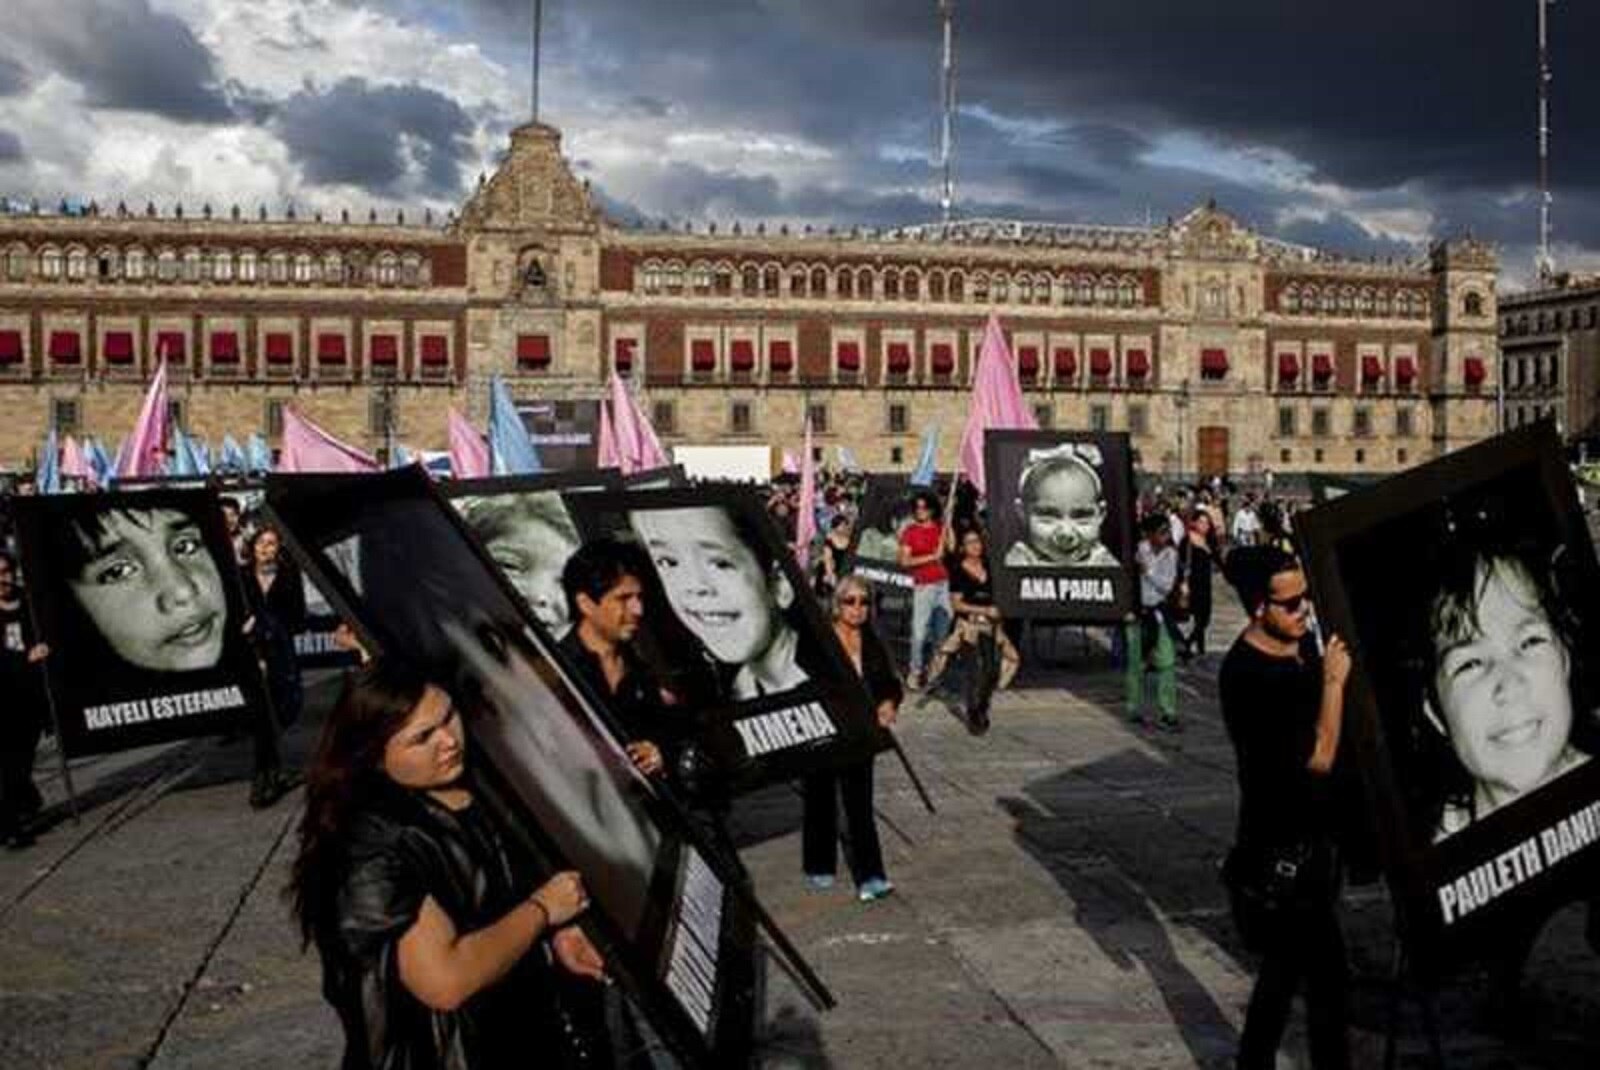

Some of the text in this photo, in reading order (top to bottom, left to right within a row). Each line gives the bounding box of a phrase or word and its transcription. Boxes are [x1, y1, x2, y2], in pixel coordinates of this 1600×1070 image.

[1020, 578, 1114, 602] ANA PAULA
[734, 701, 838, 757] XIMENA
[1437, 836, 1543, 925] PAULETH
